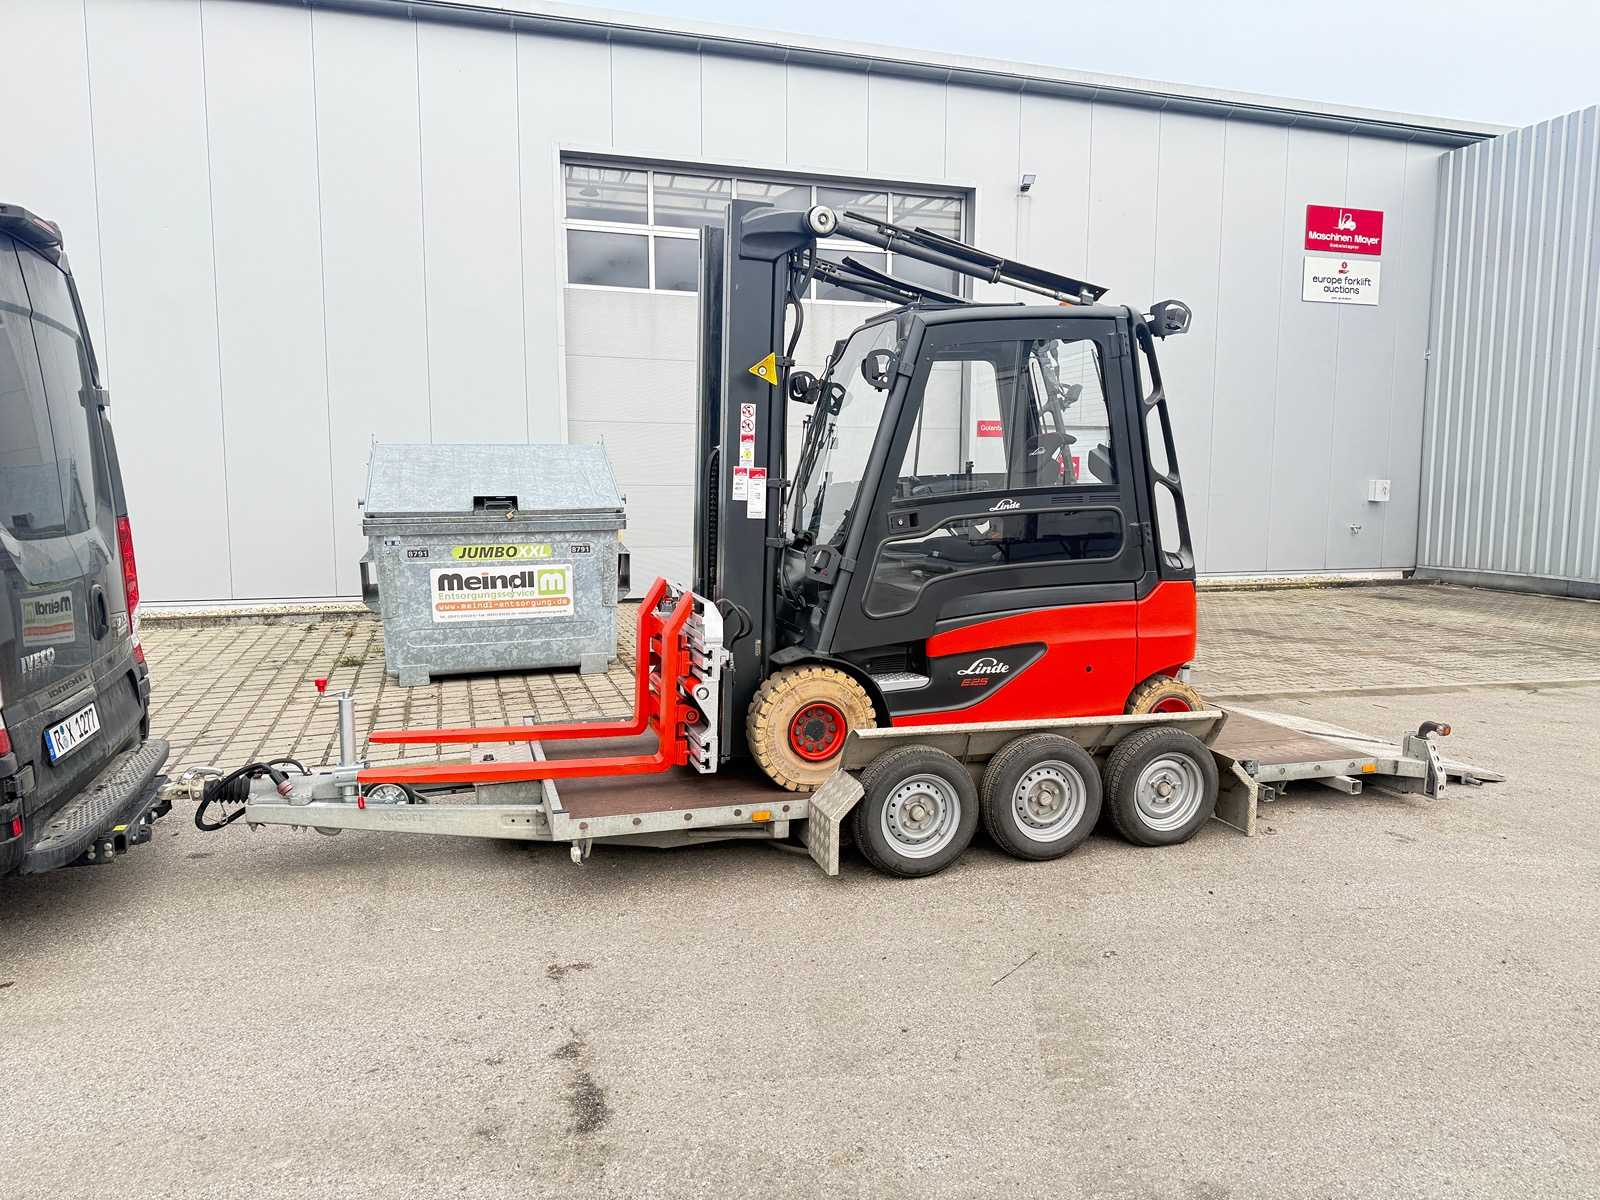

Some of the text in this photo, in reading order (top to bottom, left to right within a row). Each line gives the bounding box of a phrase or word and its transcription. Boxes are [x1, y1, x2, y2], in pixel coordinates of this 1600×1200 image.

[1308, 231, 1380, 246] Maschinen Mayer
[1312, 276, 1372, 287] europe forklift
[1323, 285, 1360, 295] auctions
[989, 498, 1021, 512] Linde
[438, 590, 535, 601] Entsorgungsservice
[437, 598, 569, 611] www.meindl-entsorgung.de
[20, 646, 56, 674] IVECO
[957, 657, 1010, 676] Linde
[75, 708, 97, 738] 1277
